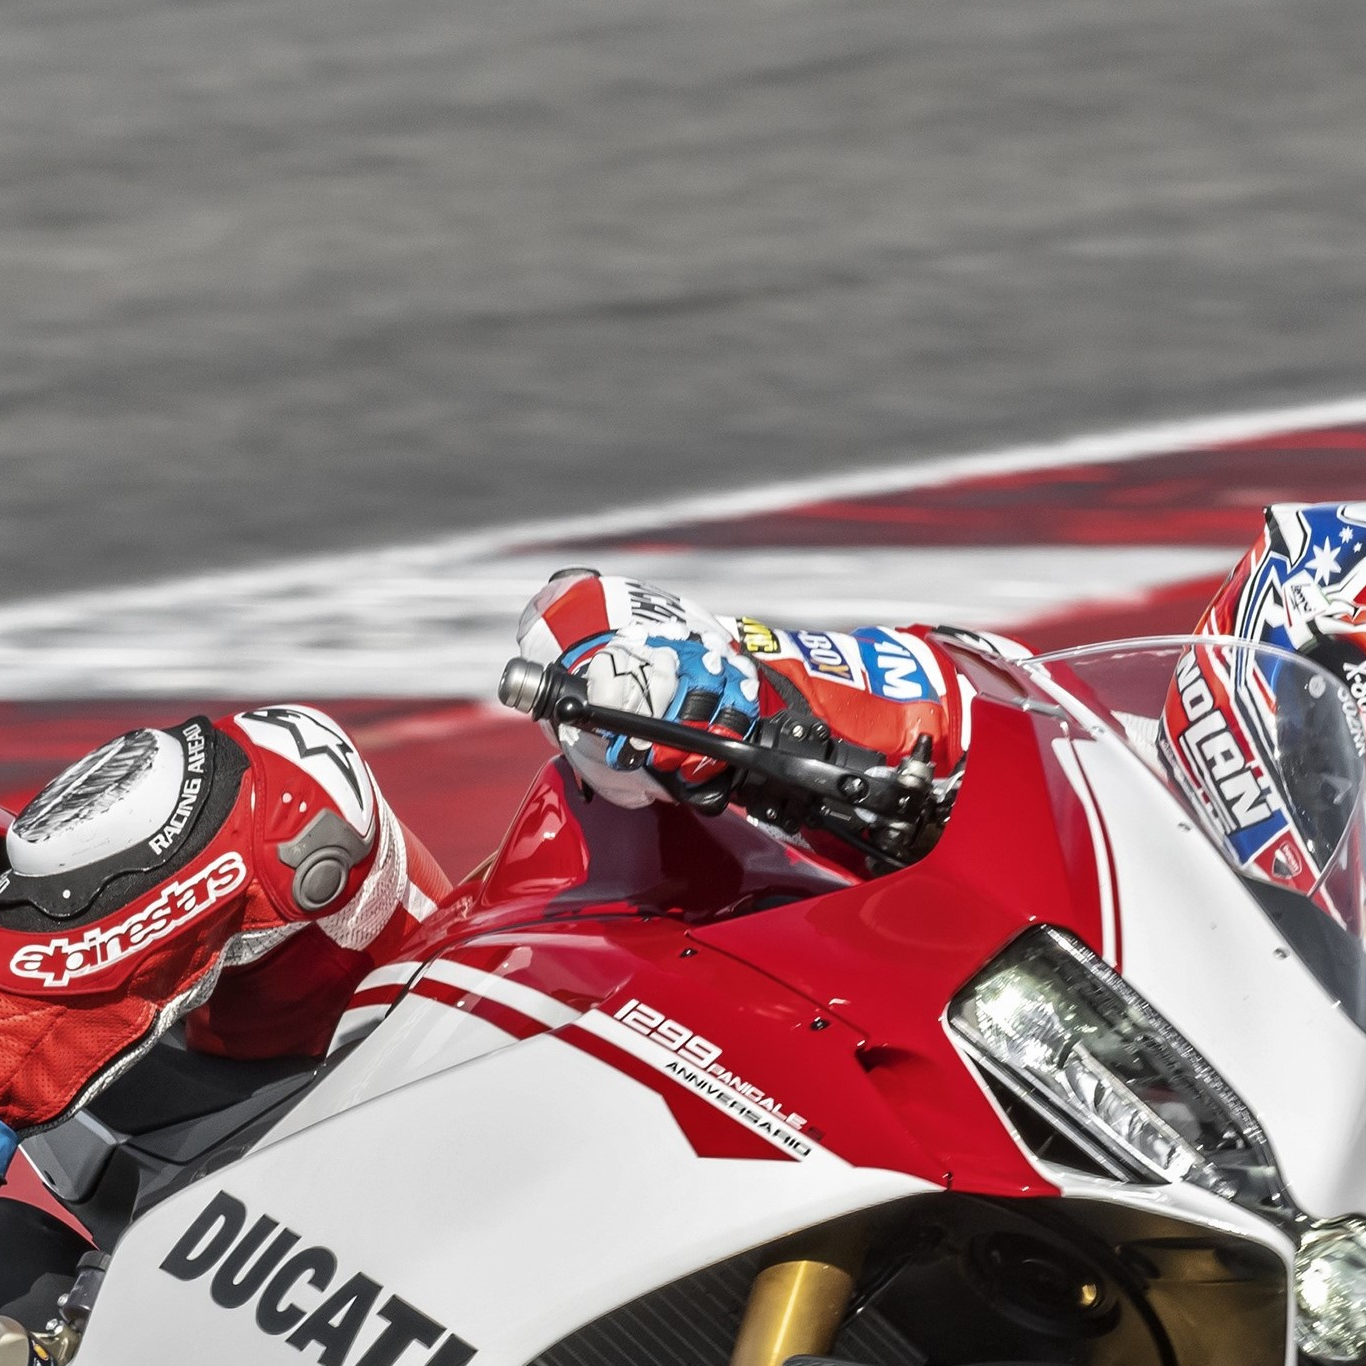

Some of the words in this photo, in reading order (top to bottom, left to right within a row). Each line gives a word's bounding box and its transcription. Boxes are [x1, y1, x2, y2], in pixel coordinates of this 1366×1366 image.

[149, 778, 201, 854] RACING
[183, 724, 206, 774] AHEAD
[1176, 648, 1272, 834] NOLAN
[614, 998, 723, 1069] 1299
[707, 1064, 808, 1130] PANIGALE
[665, 1061, 811, 1157] ANNIVERSARIO
